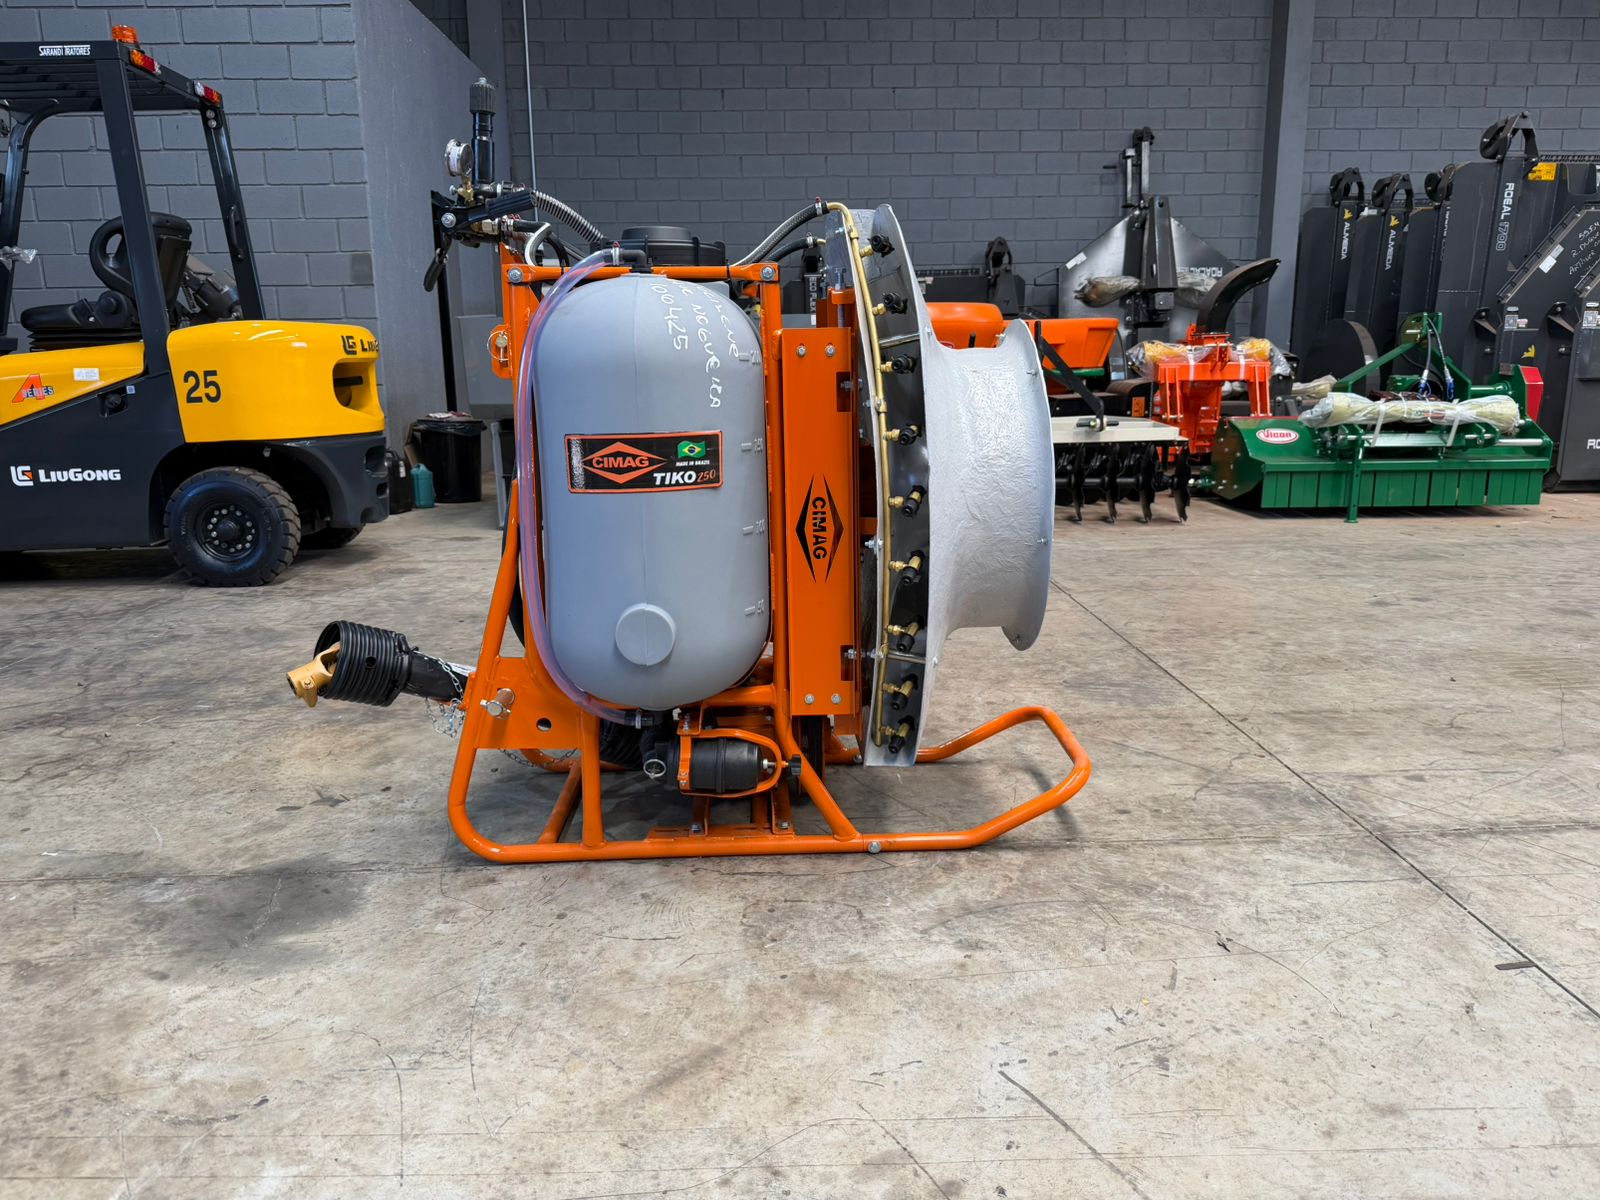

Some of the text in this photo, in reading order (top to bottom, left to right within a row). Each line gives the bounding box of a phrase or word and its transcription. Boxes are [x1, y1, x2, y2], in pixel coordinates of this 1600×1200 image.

[39, 45, 64, 57] SARANDI
[22, 386, 55, 399] SERIES
[183, 370, 222, 404] 25
[592, 456, 650, 469] CIMAG
[653, 468, 716, 486] TIKO 250
[812, 496, 828, 560] CIMAG
